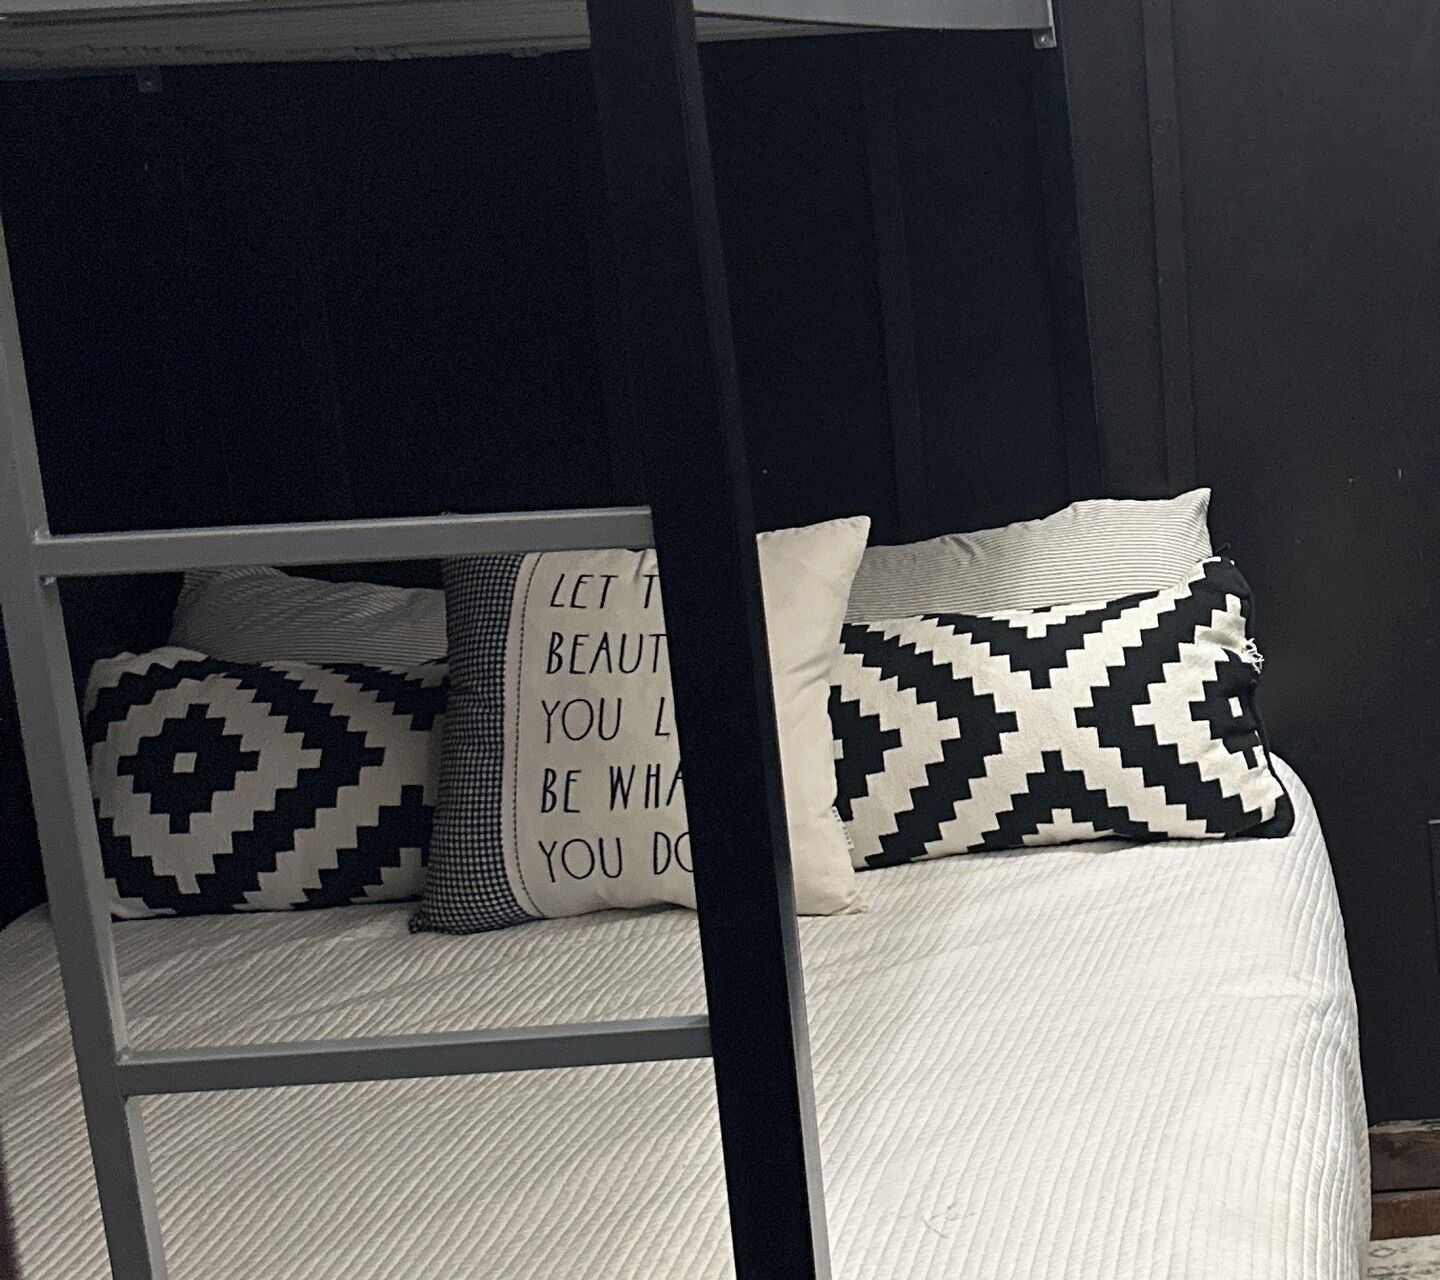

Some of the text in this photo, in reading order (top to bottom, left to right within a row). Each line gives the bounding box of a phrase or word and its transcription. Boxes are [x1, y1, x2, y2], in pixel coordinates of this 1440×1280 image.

[550, 573, 619, 609] LET
[541, 697, 622, 744] YOU
[541, 767, 582, 813] BE
[538, 837, 623, 883] YOU
